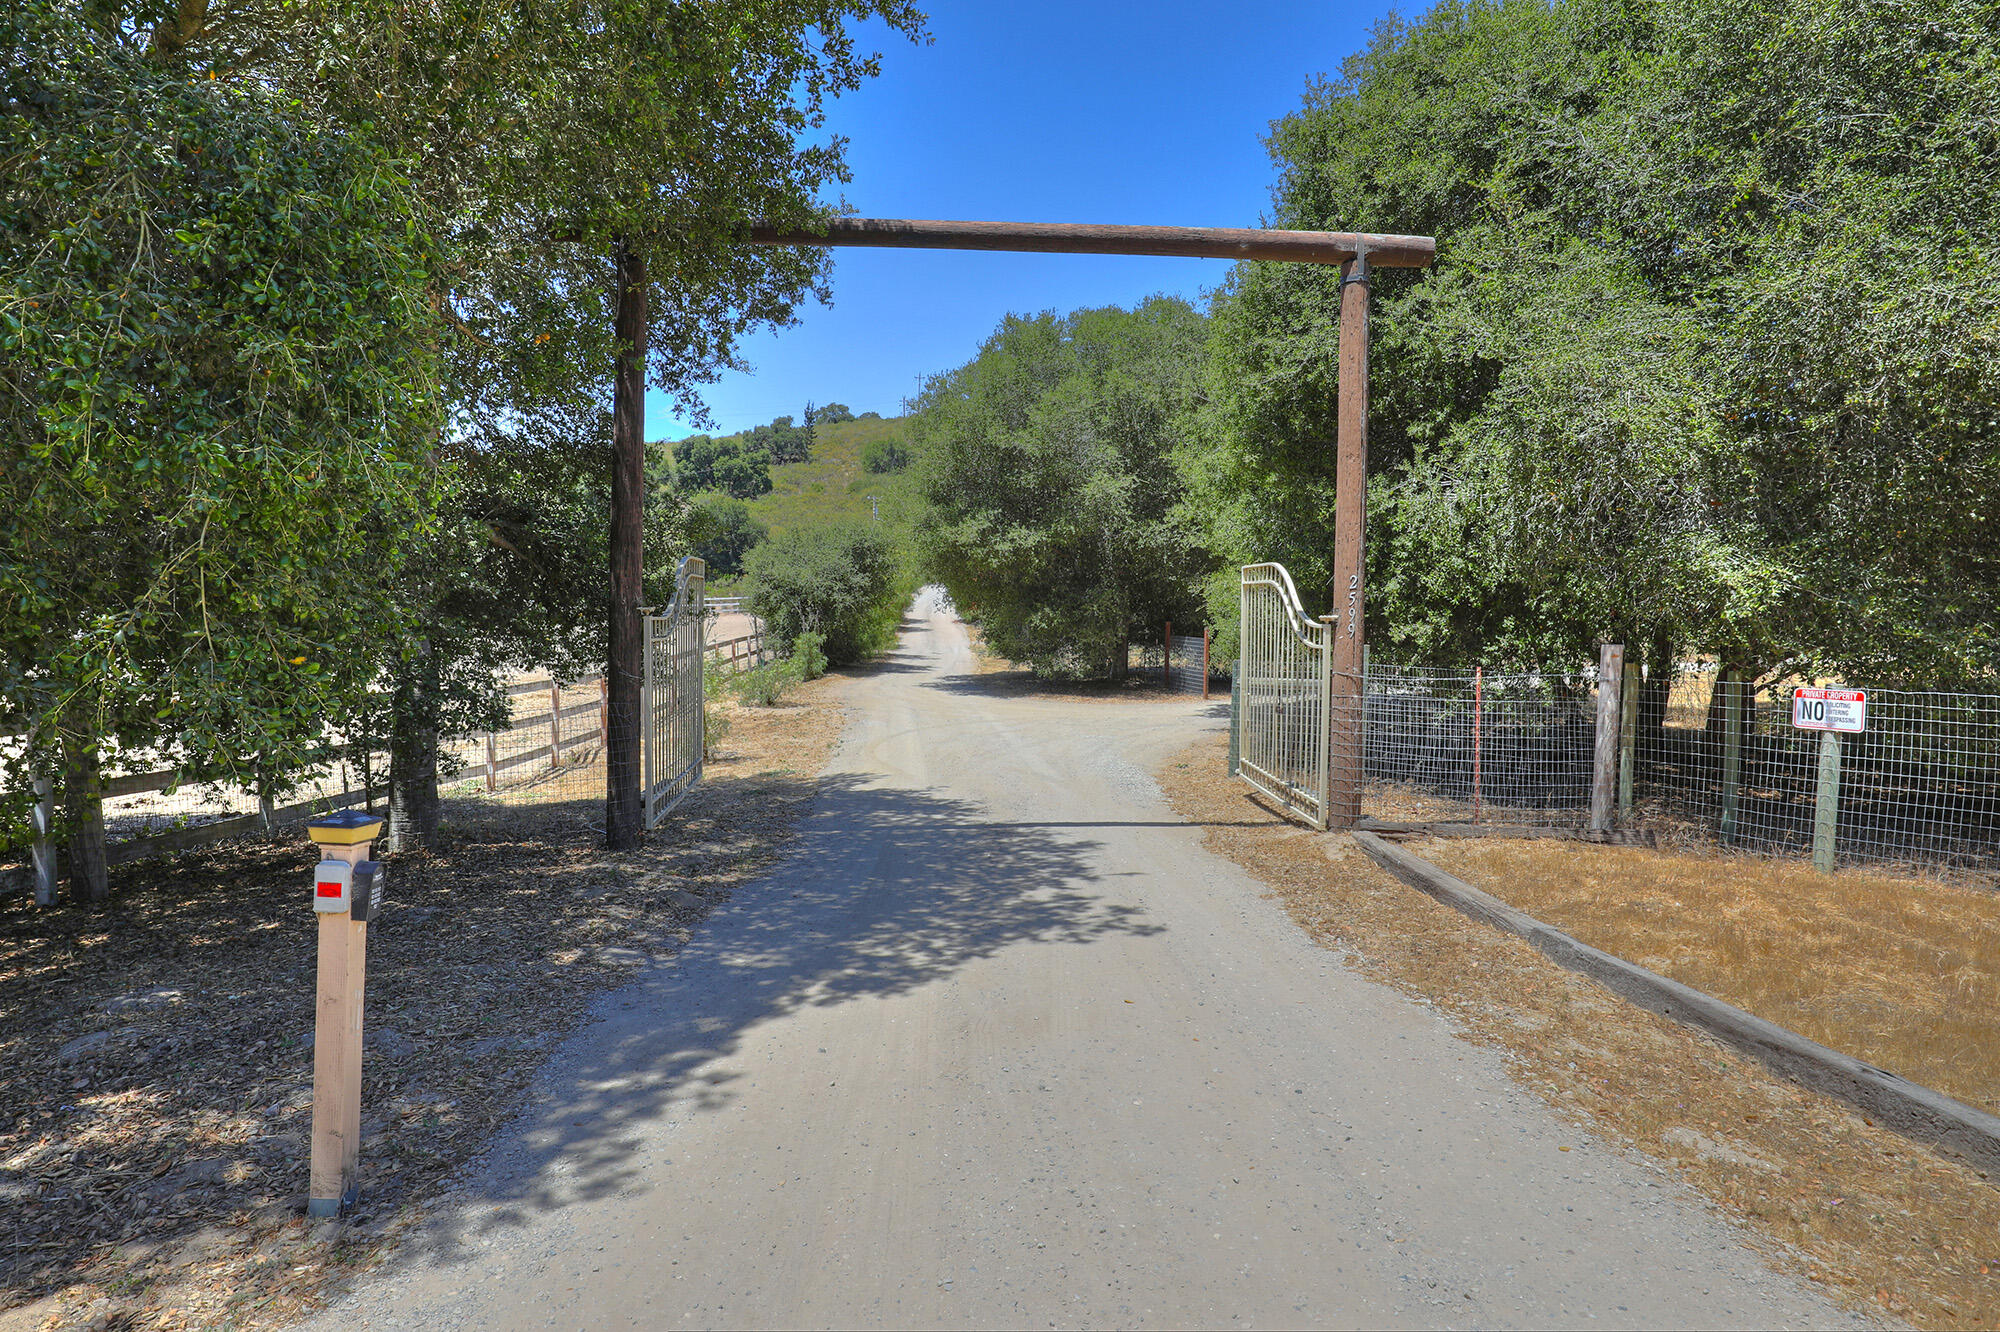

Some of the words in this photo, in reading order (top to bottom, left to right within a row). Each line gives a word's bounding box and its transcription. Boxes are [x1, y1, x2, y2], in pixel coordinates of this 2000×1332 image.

[1348, 574, 1358, 638] 2599
[1802, 690, 1826, 698] PRIVATE
[1827, 691, 1857, 700] PROPERTY
[1802, 701, 1824, 721] NO
